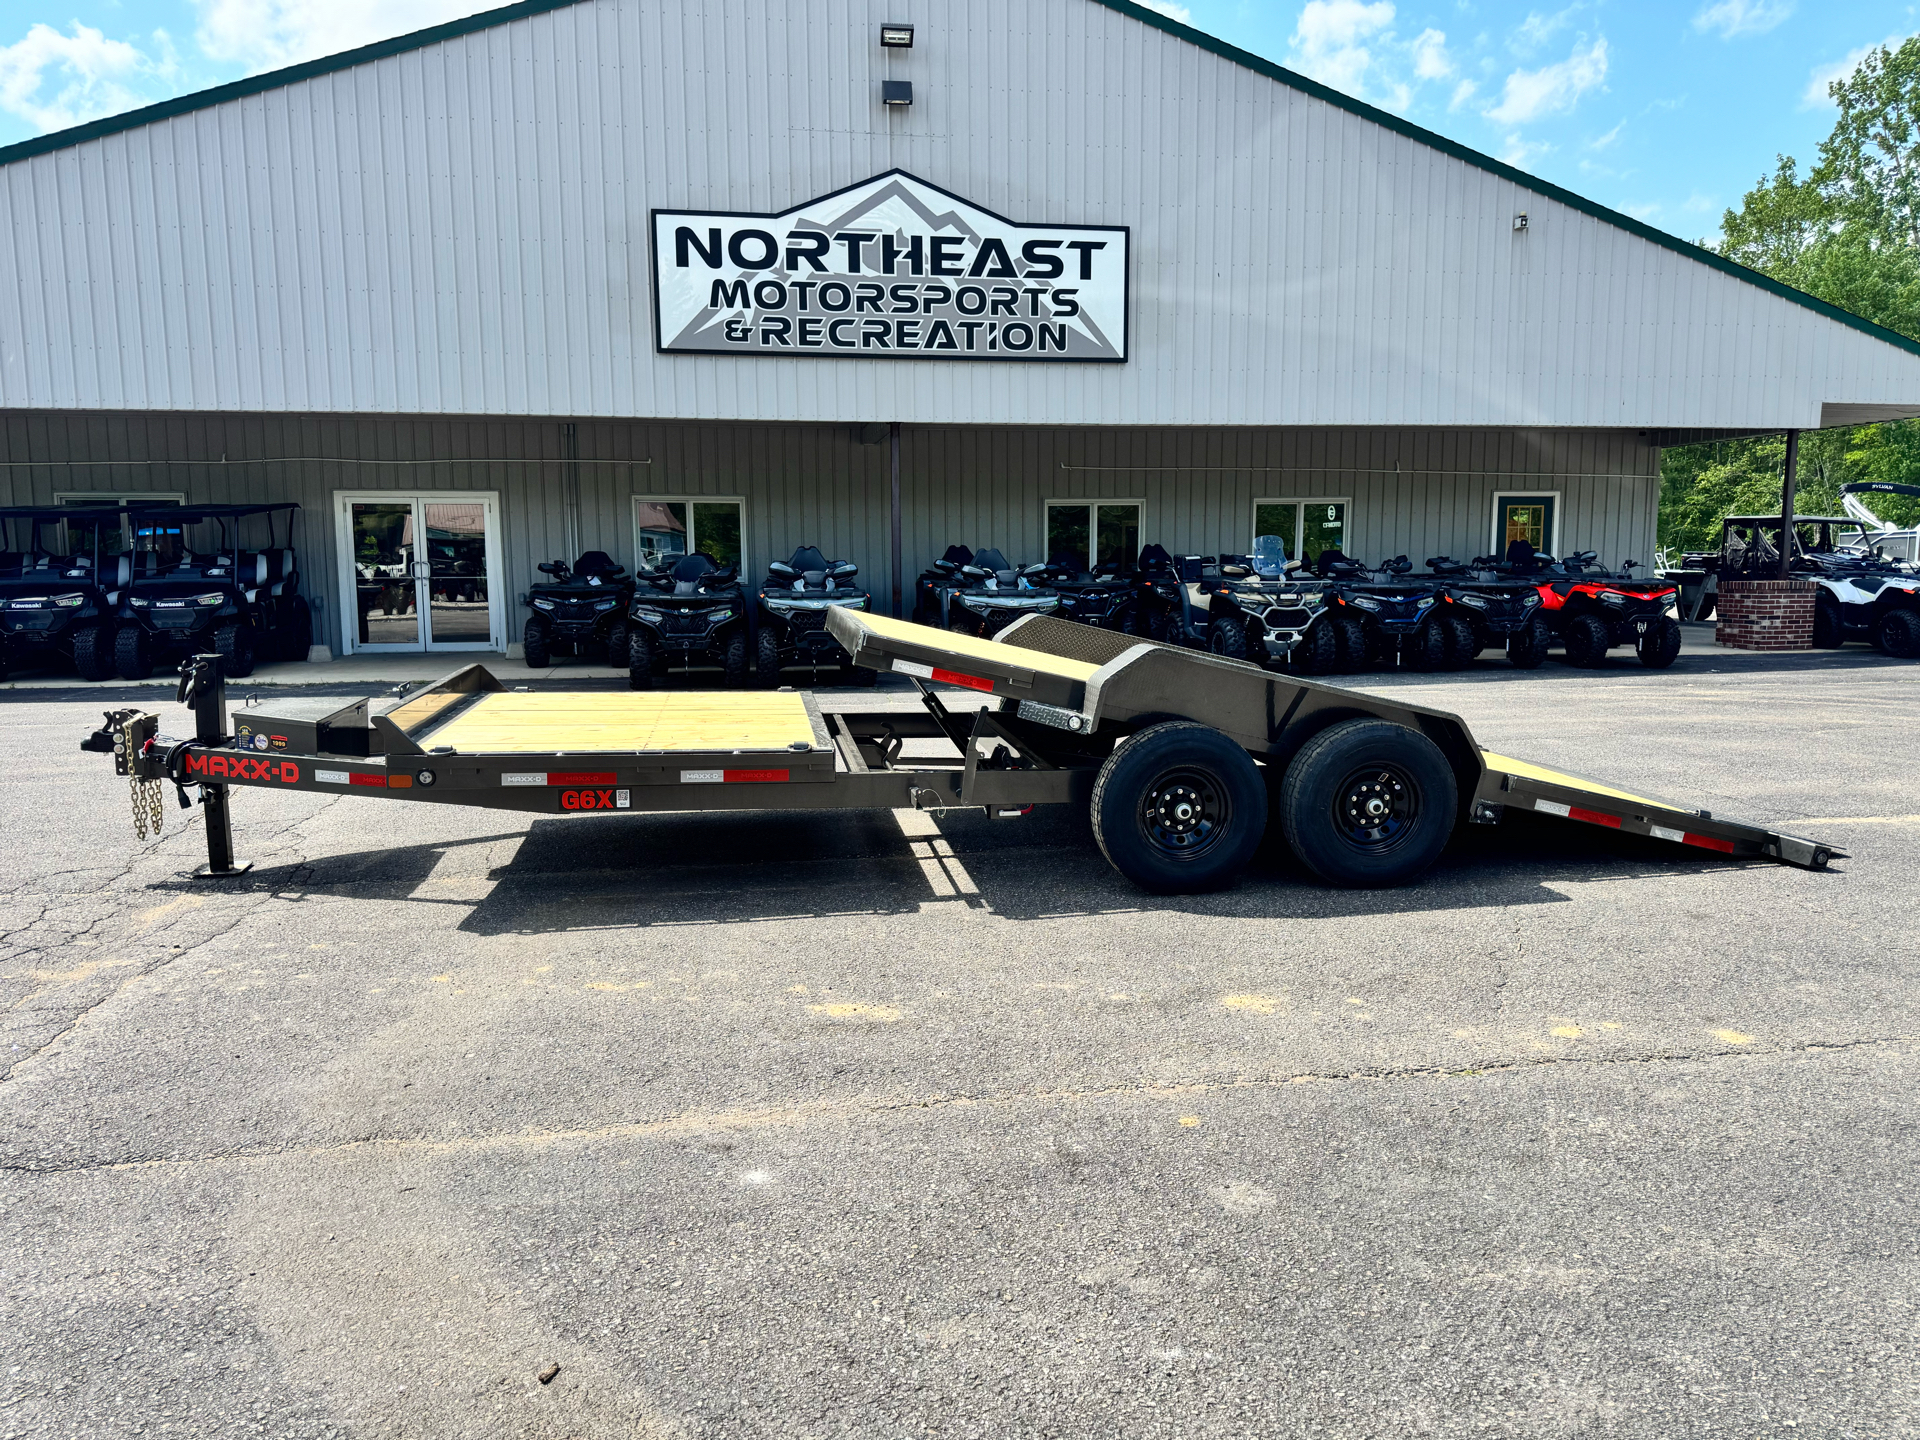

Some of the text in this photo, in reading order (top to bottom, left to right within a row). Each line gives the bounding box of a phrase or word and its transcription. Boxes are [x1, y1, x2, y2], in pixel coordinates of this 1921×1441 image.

[674, 225, 1107, 280] NORTHEAST
[708, 278, 1080, 317] MOTORSPORTS
[185, 753, 300, 783] MAXX-D
[319, 773, 346, 781] MAXX-D
[561, 789, 614, 809] G6X
